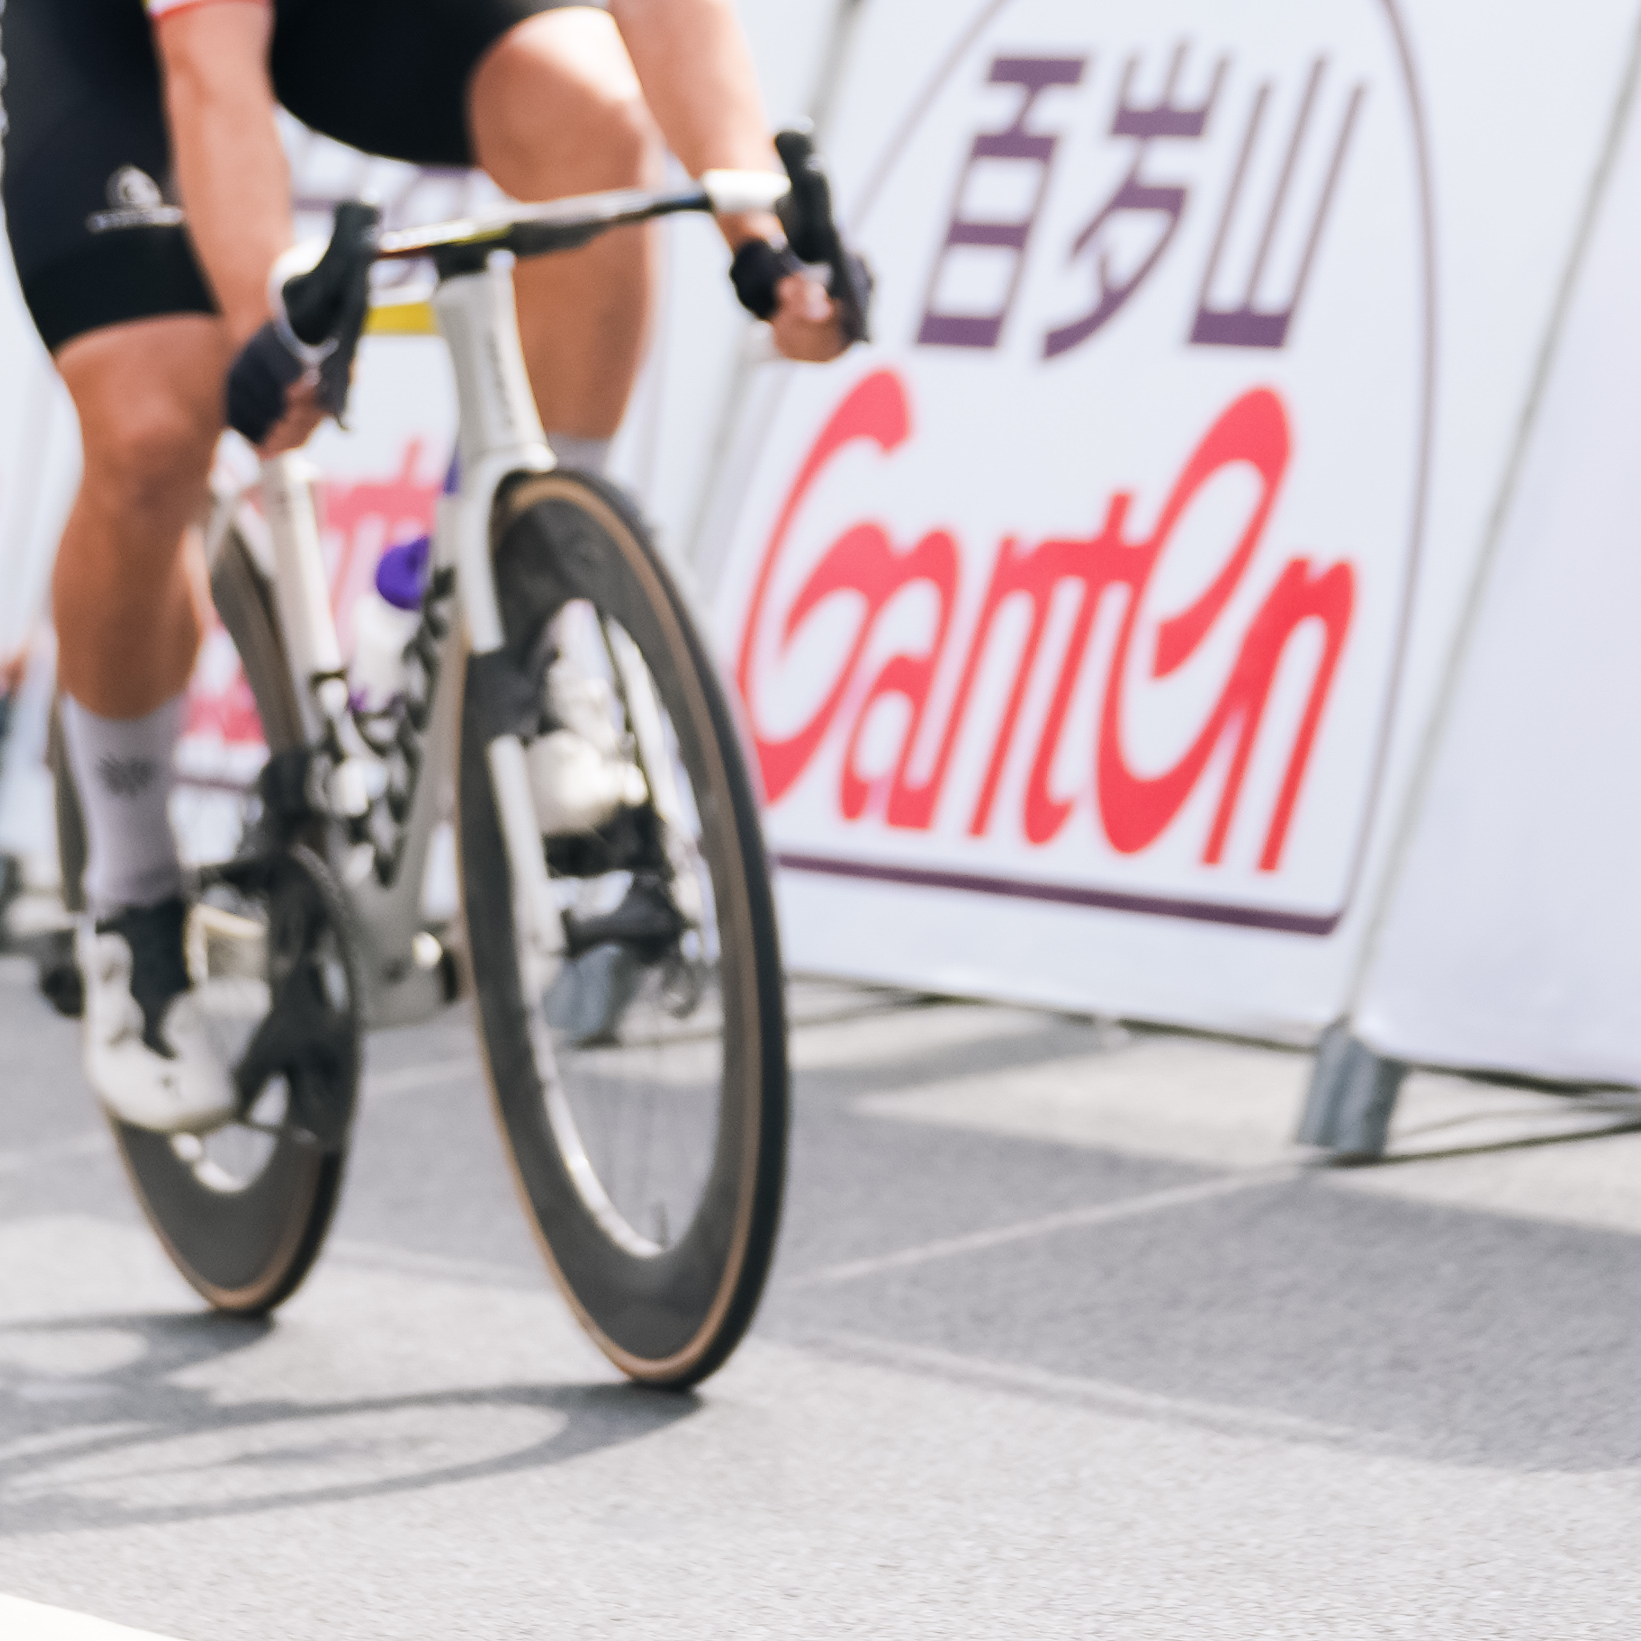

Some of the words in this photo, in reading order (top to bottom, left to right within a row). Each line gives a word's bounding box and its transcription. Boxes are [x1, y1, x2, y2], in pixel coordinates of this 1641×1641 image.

[918, 40, 1369, 363] 百岁山
[735, 369, 1358, 874] Ganten
